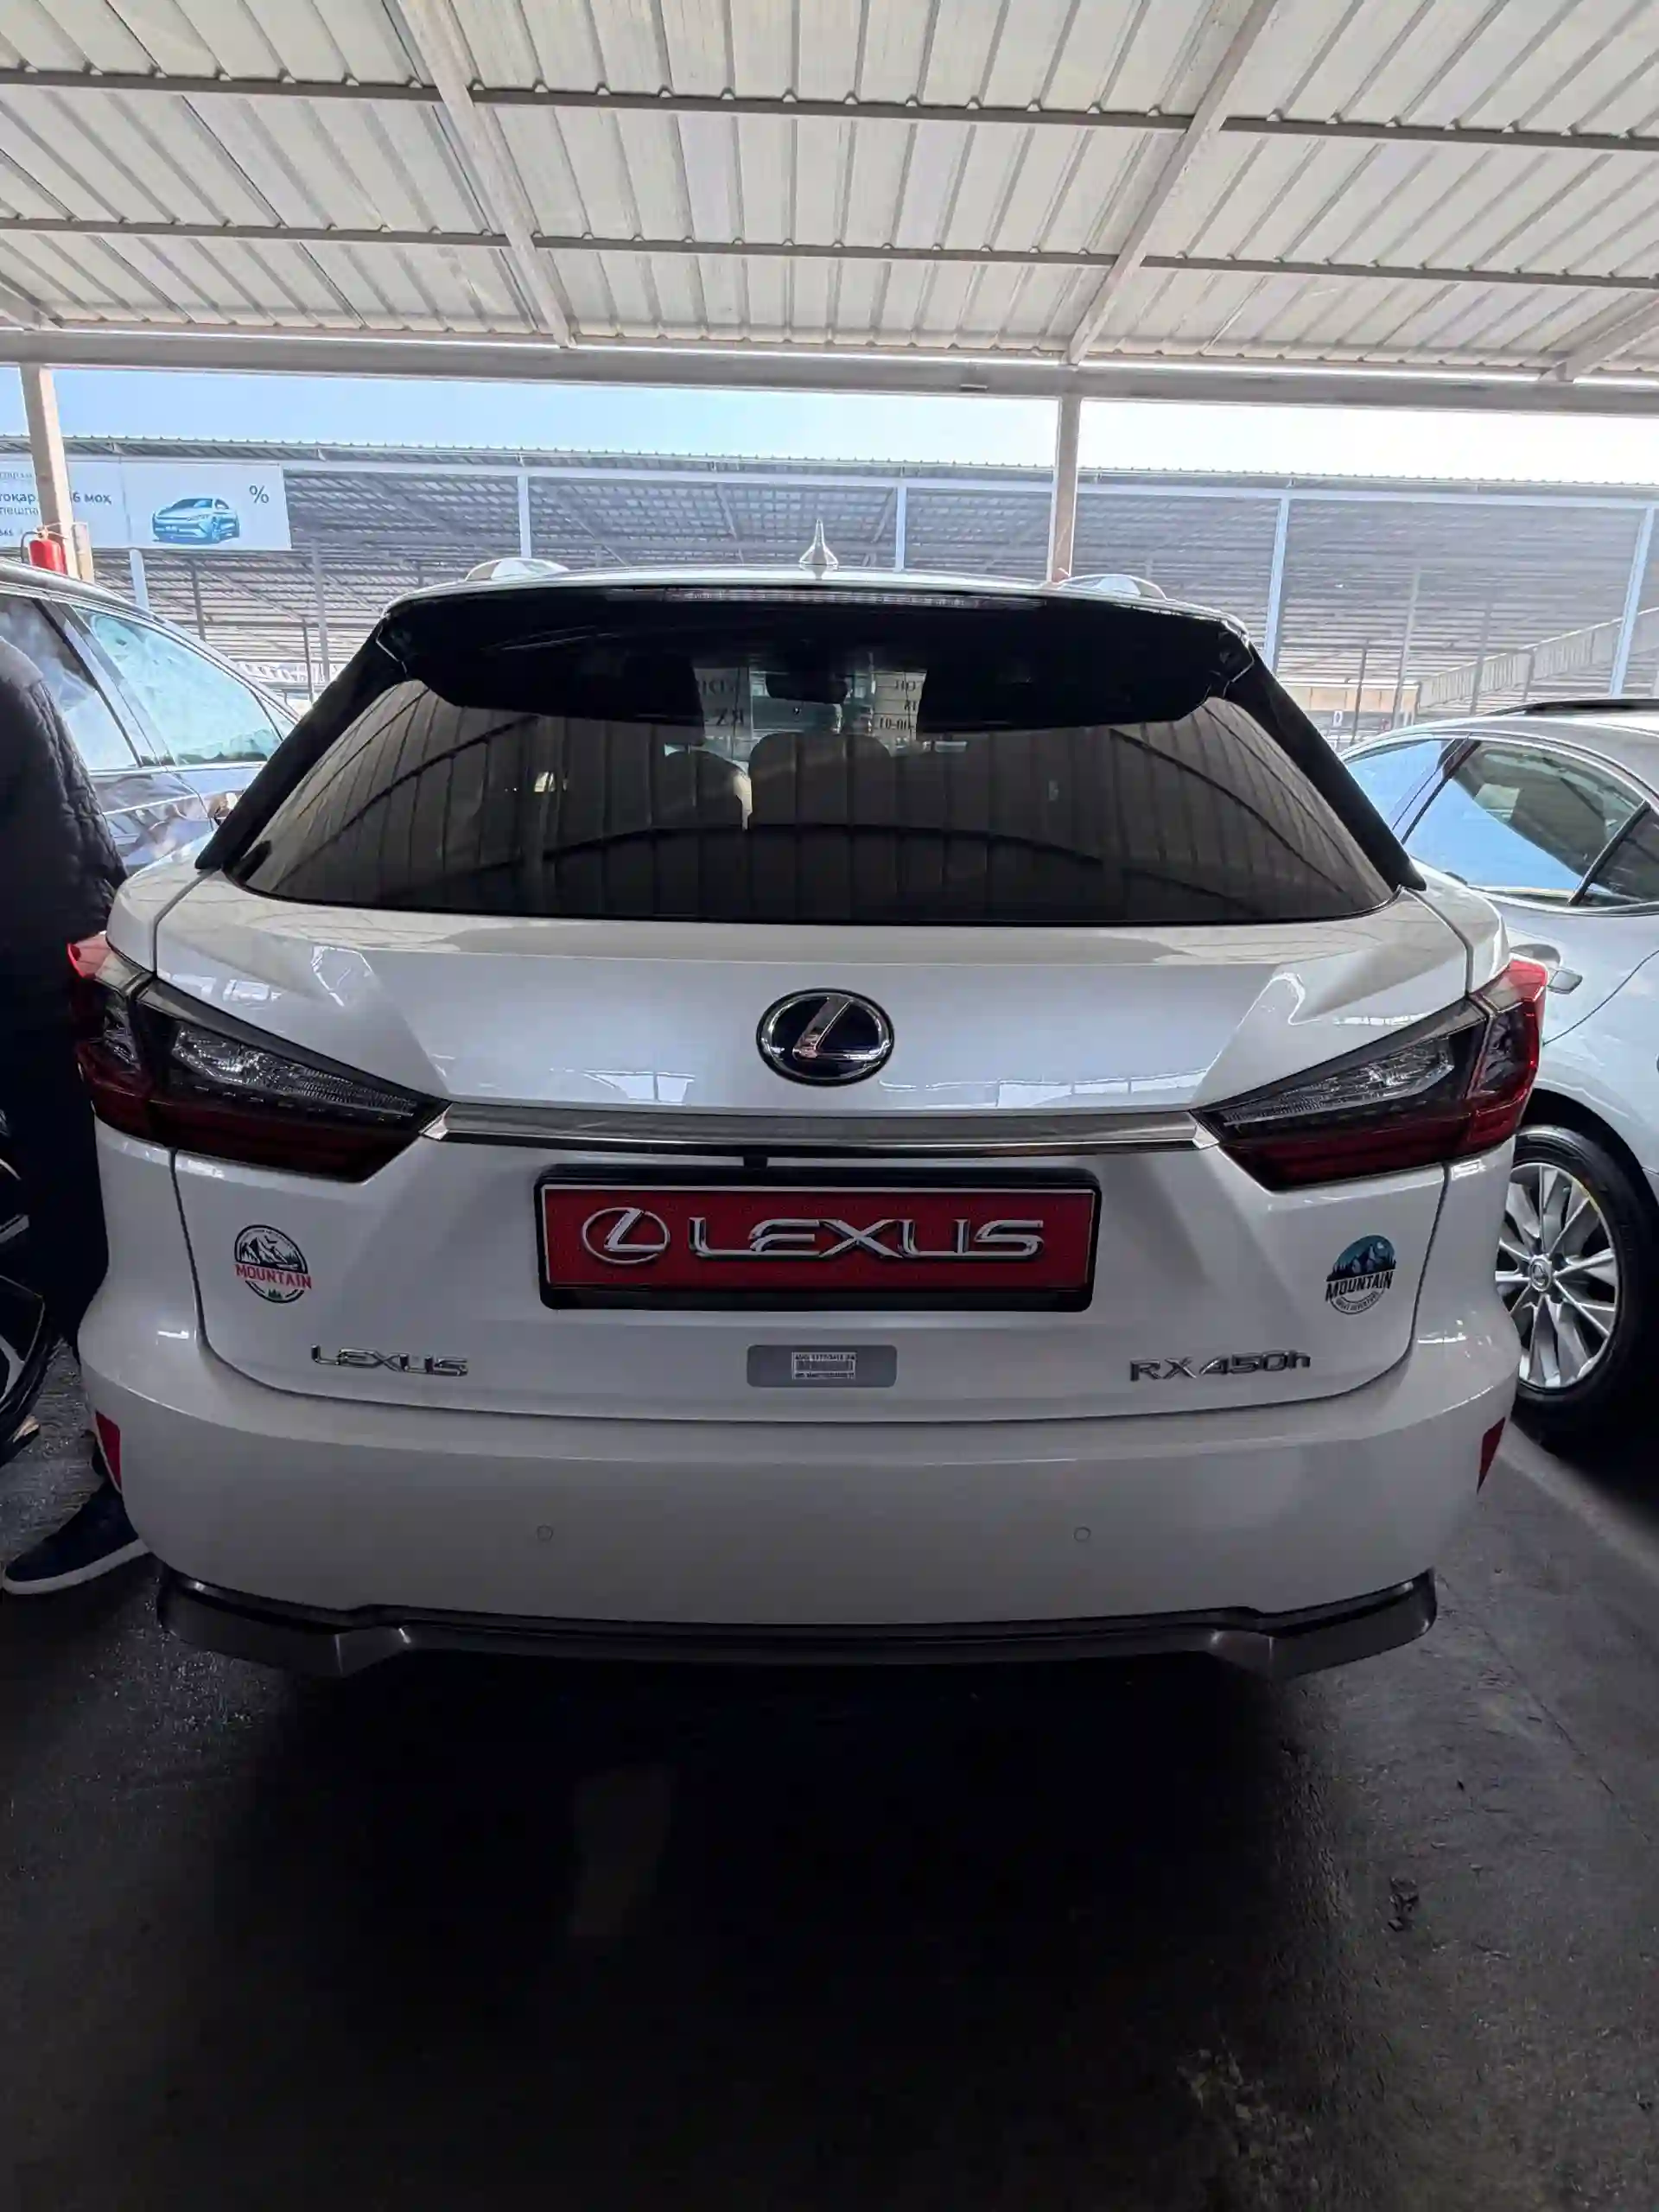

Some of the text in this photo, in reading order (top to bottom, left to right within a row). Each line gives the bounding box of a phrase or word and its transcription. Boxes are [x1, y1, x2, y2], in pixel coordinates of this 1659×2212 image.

[249, 485, 270, 504] %
[689, 1216, 1045, 1258] LEXUS
[234, 1263, 312, 1288] MOUNTAIN
[1325, 1270, 1394, 1301] MOUNTAIN
[311, 1344, 468, 1376] LEXUS
